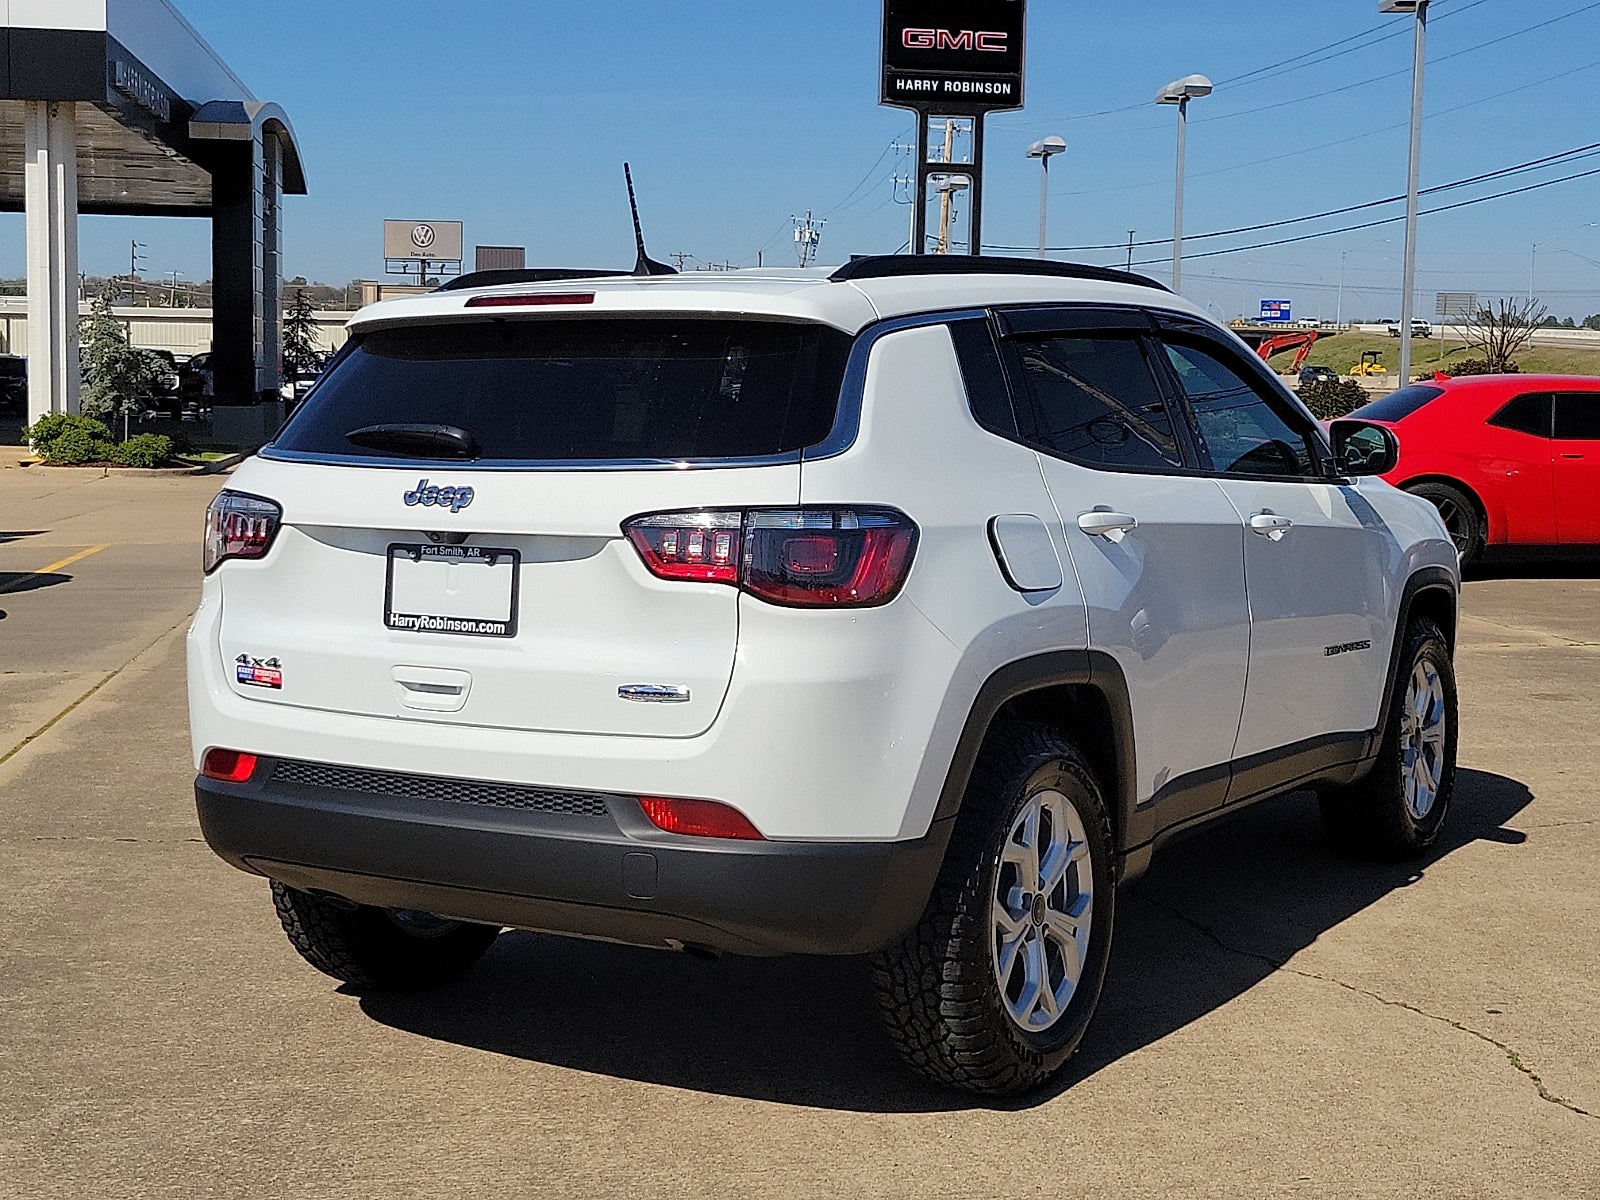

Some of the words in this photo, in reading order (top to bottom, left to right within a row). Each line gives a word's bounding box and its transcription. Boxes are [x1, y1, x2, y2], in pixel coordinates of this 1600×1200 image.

[902, 28, 1007, 52] GMC
[896, 79, 938, 91] HARRY
[944, 81, 1011, 94] ROBINSON
[404, 479, 474, 513] Jeep
[421, 546, 438, 555] Fort
[439, 547, 466, 558] Smith,
[467, 548, 480, 557] AR
[390, 614, 506, 634] HarryRobinson.com
[235, 653, 282, 669] 4x4
